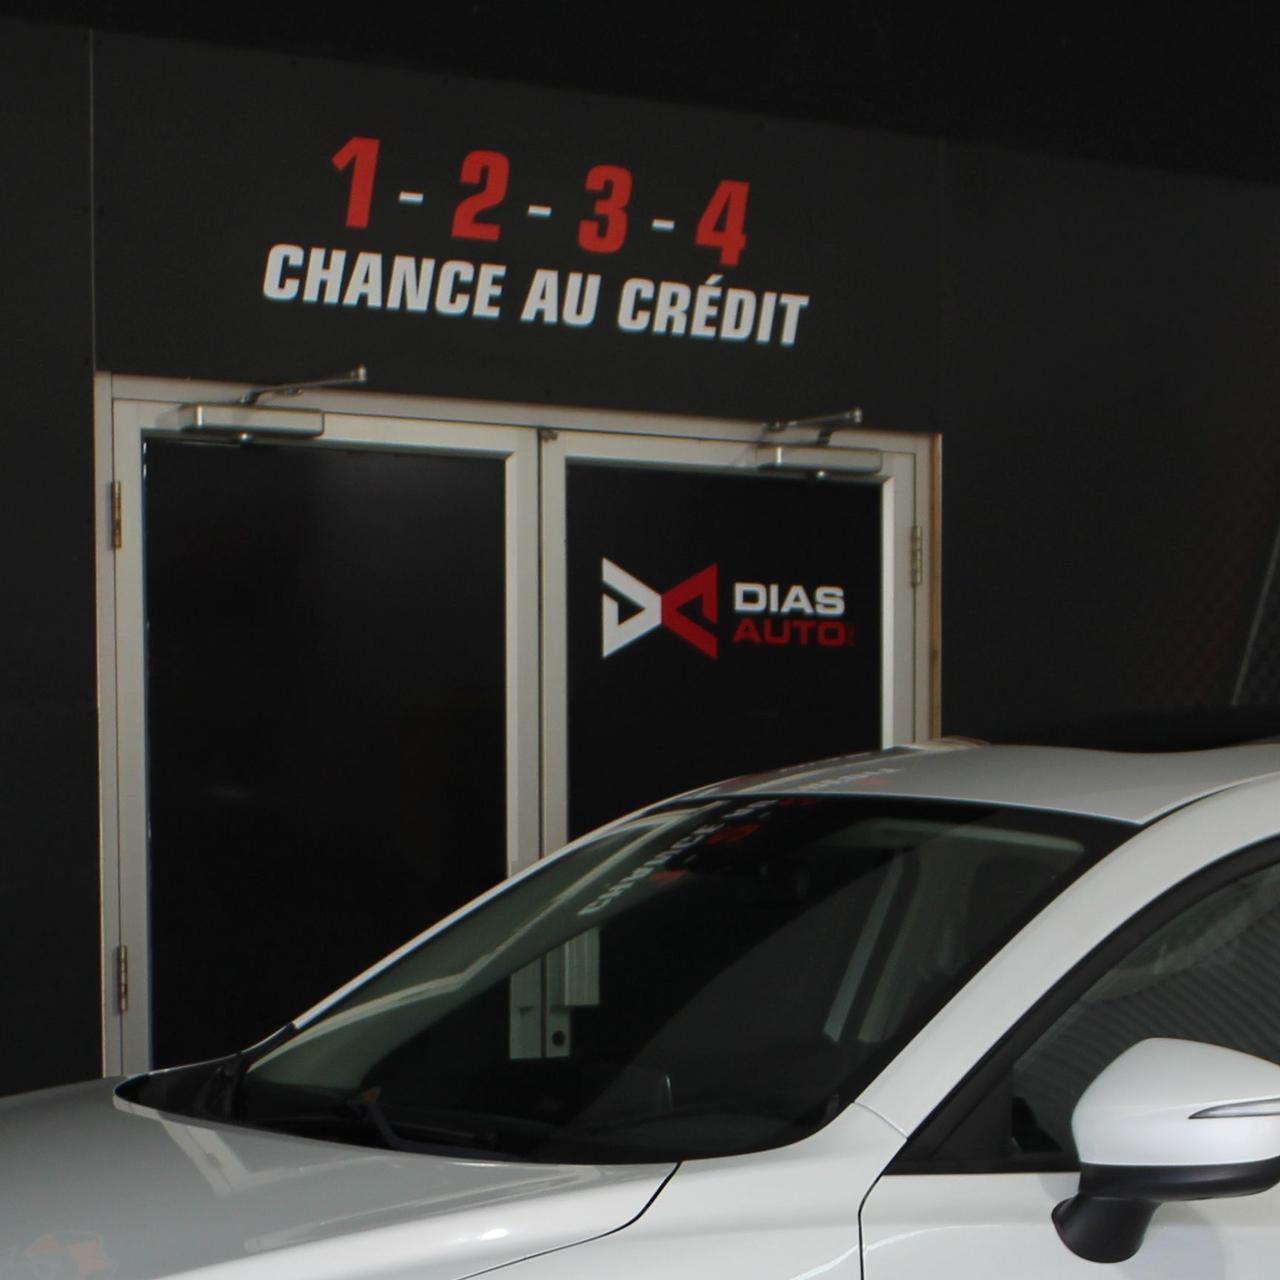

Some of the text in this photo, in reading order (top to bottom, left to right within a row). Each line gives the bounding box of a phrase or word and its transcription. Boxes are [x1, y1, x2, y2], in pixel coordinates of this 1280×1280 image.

[262, 243, 810, 345] CHANCE AU CRÉDIT
[734, 582, 846, 617] DIAS
[732, 617, 848, 648] AUTO
